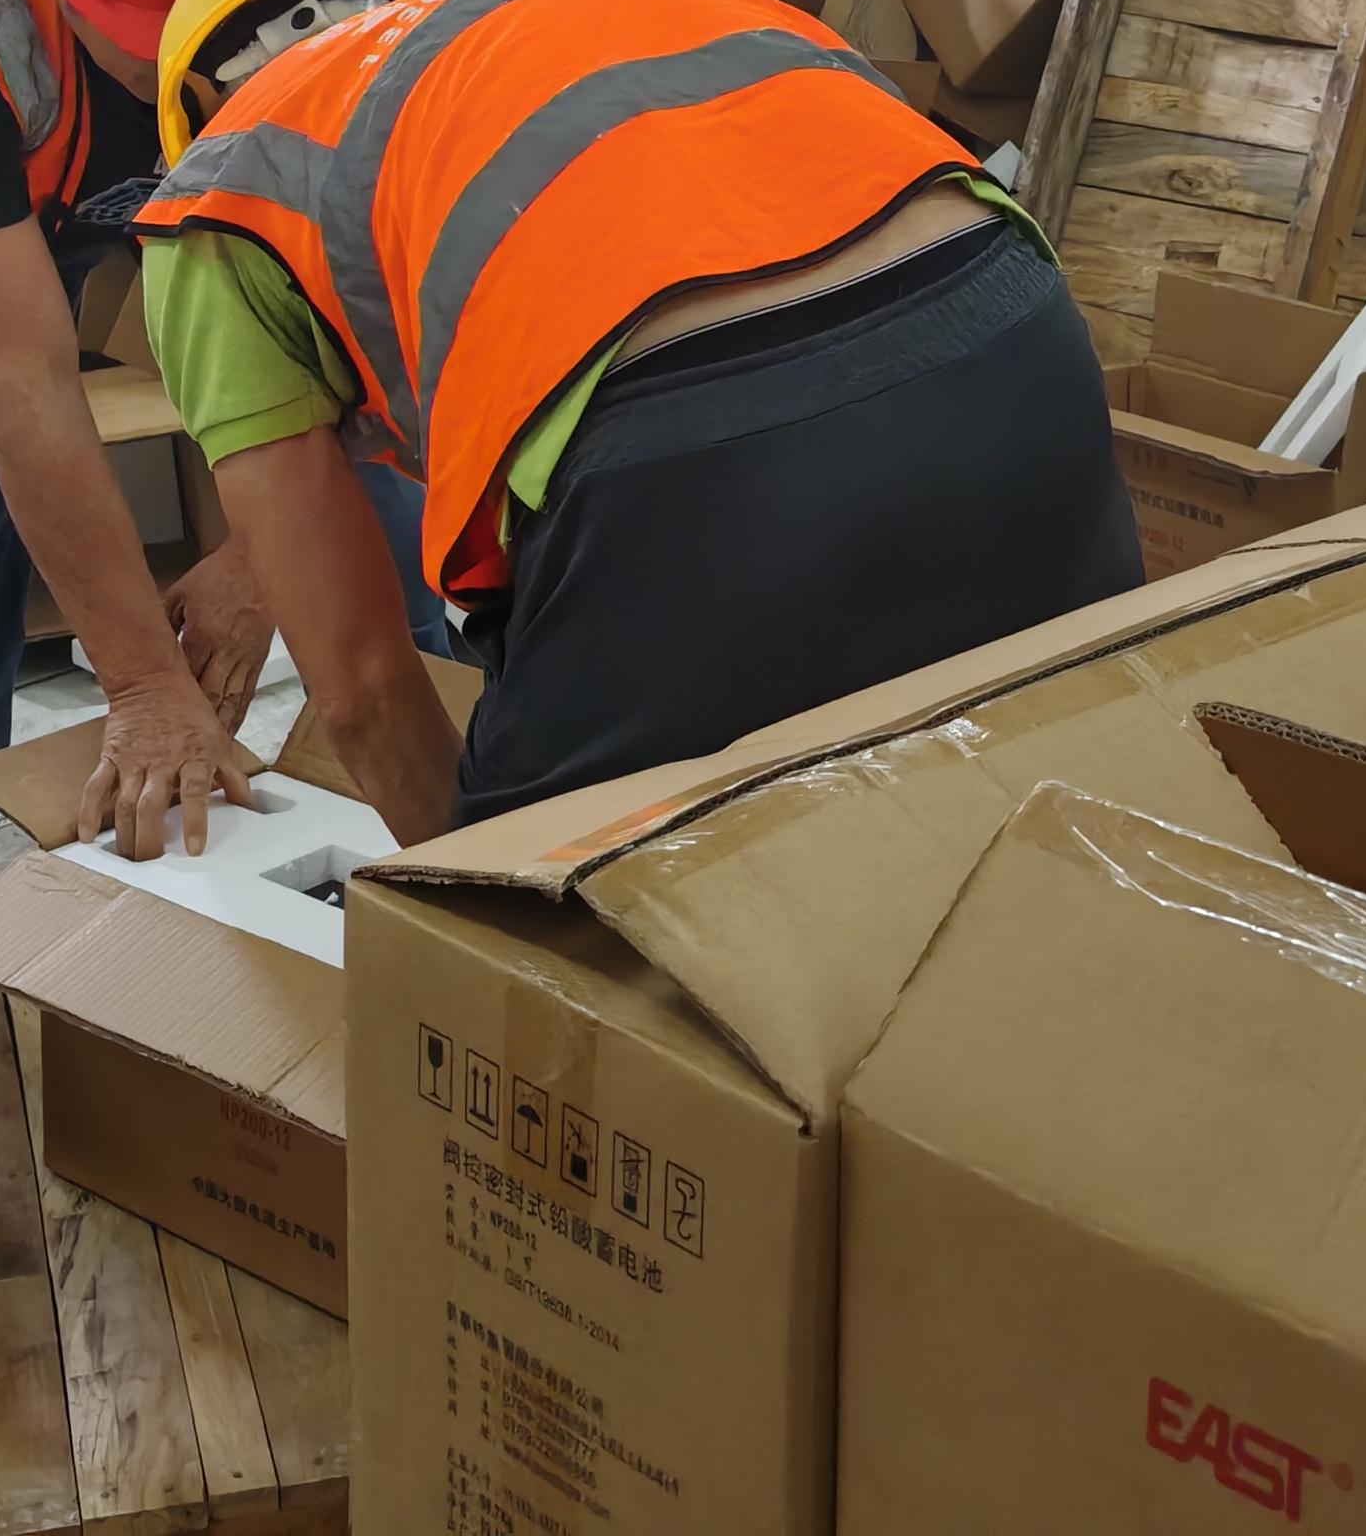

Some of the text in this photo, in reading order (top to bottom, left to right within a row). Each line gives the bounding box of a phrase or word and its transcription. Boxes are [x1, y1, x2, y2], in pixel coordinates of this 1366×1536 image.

[443, 1137, 664, 1294] 阀控密封式铅酸蓄电池
[1145, 1376, 1322, 1523] EAST
